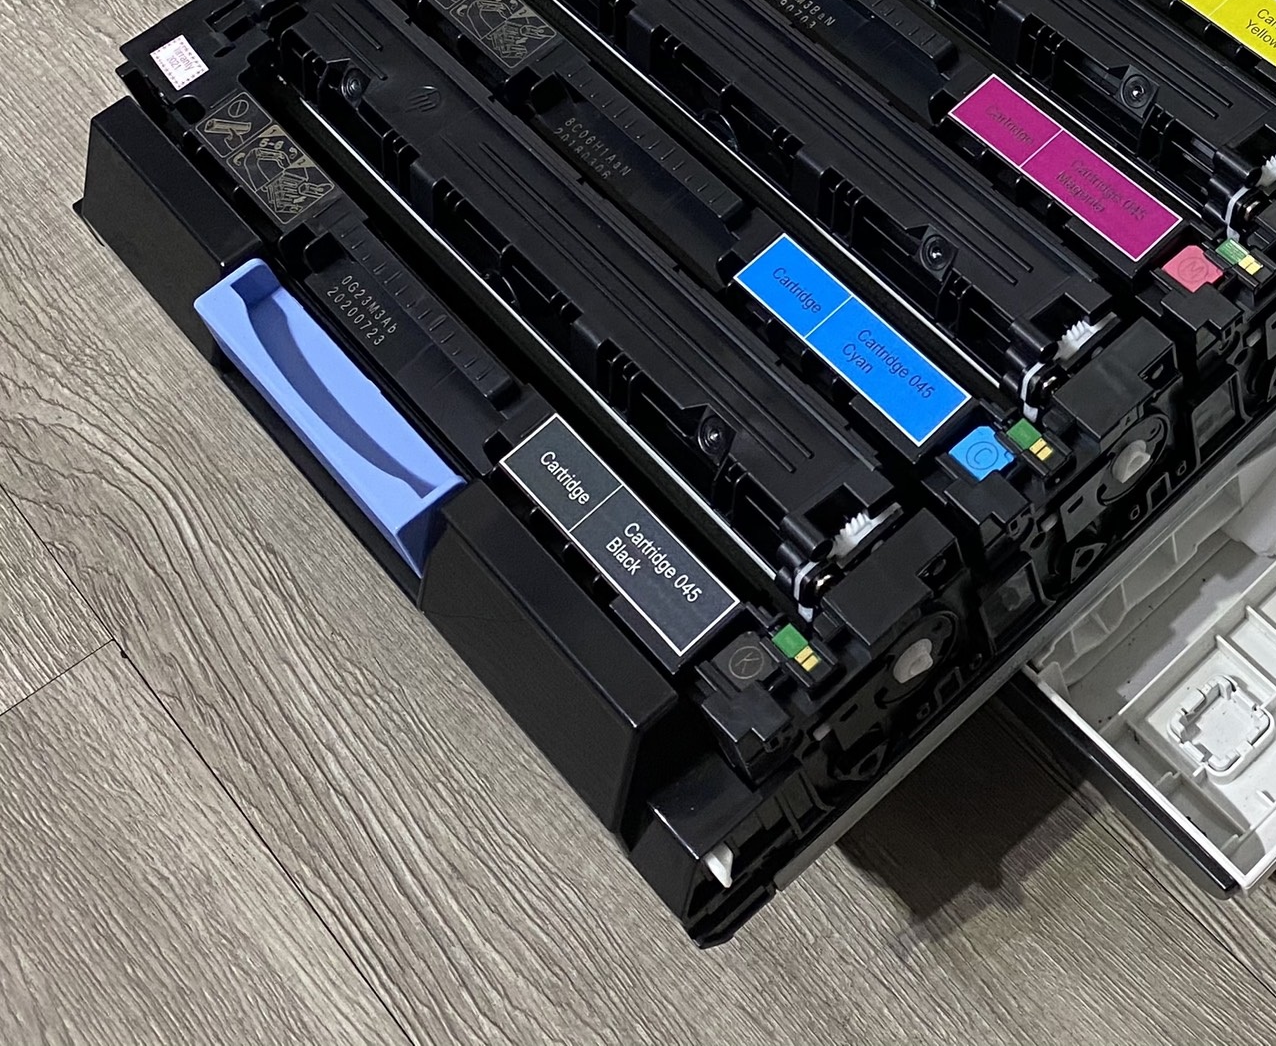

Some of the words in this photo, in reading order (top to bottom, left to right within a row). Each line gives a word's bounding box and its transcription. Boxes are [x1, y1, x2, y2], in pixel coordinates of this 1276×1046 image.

[985, 106, 1035, 146] Cartridge
[1056, 171, 1105, 213] Magenta
[772, 267, 822, 314] Cartridge
[327, 286, 385, 346] 20200723
[842, 343, 873, 374] Cyan
[857, 329, 909, 379] Cartridge
[908, 373, 936, 400] 045
[539, 451, 590, 505] Cartridge
[605, 536, 642, 576] Black
[624, 522, 676, 579] Cartridge
[674, 573, 703, 602] 045
